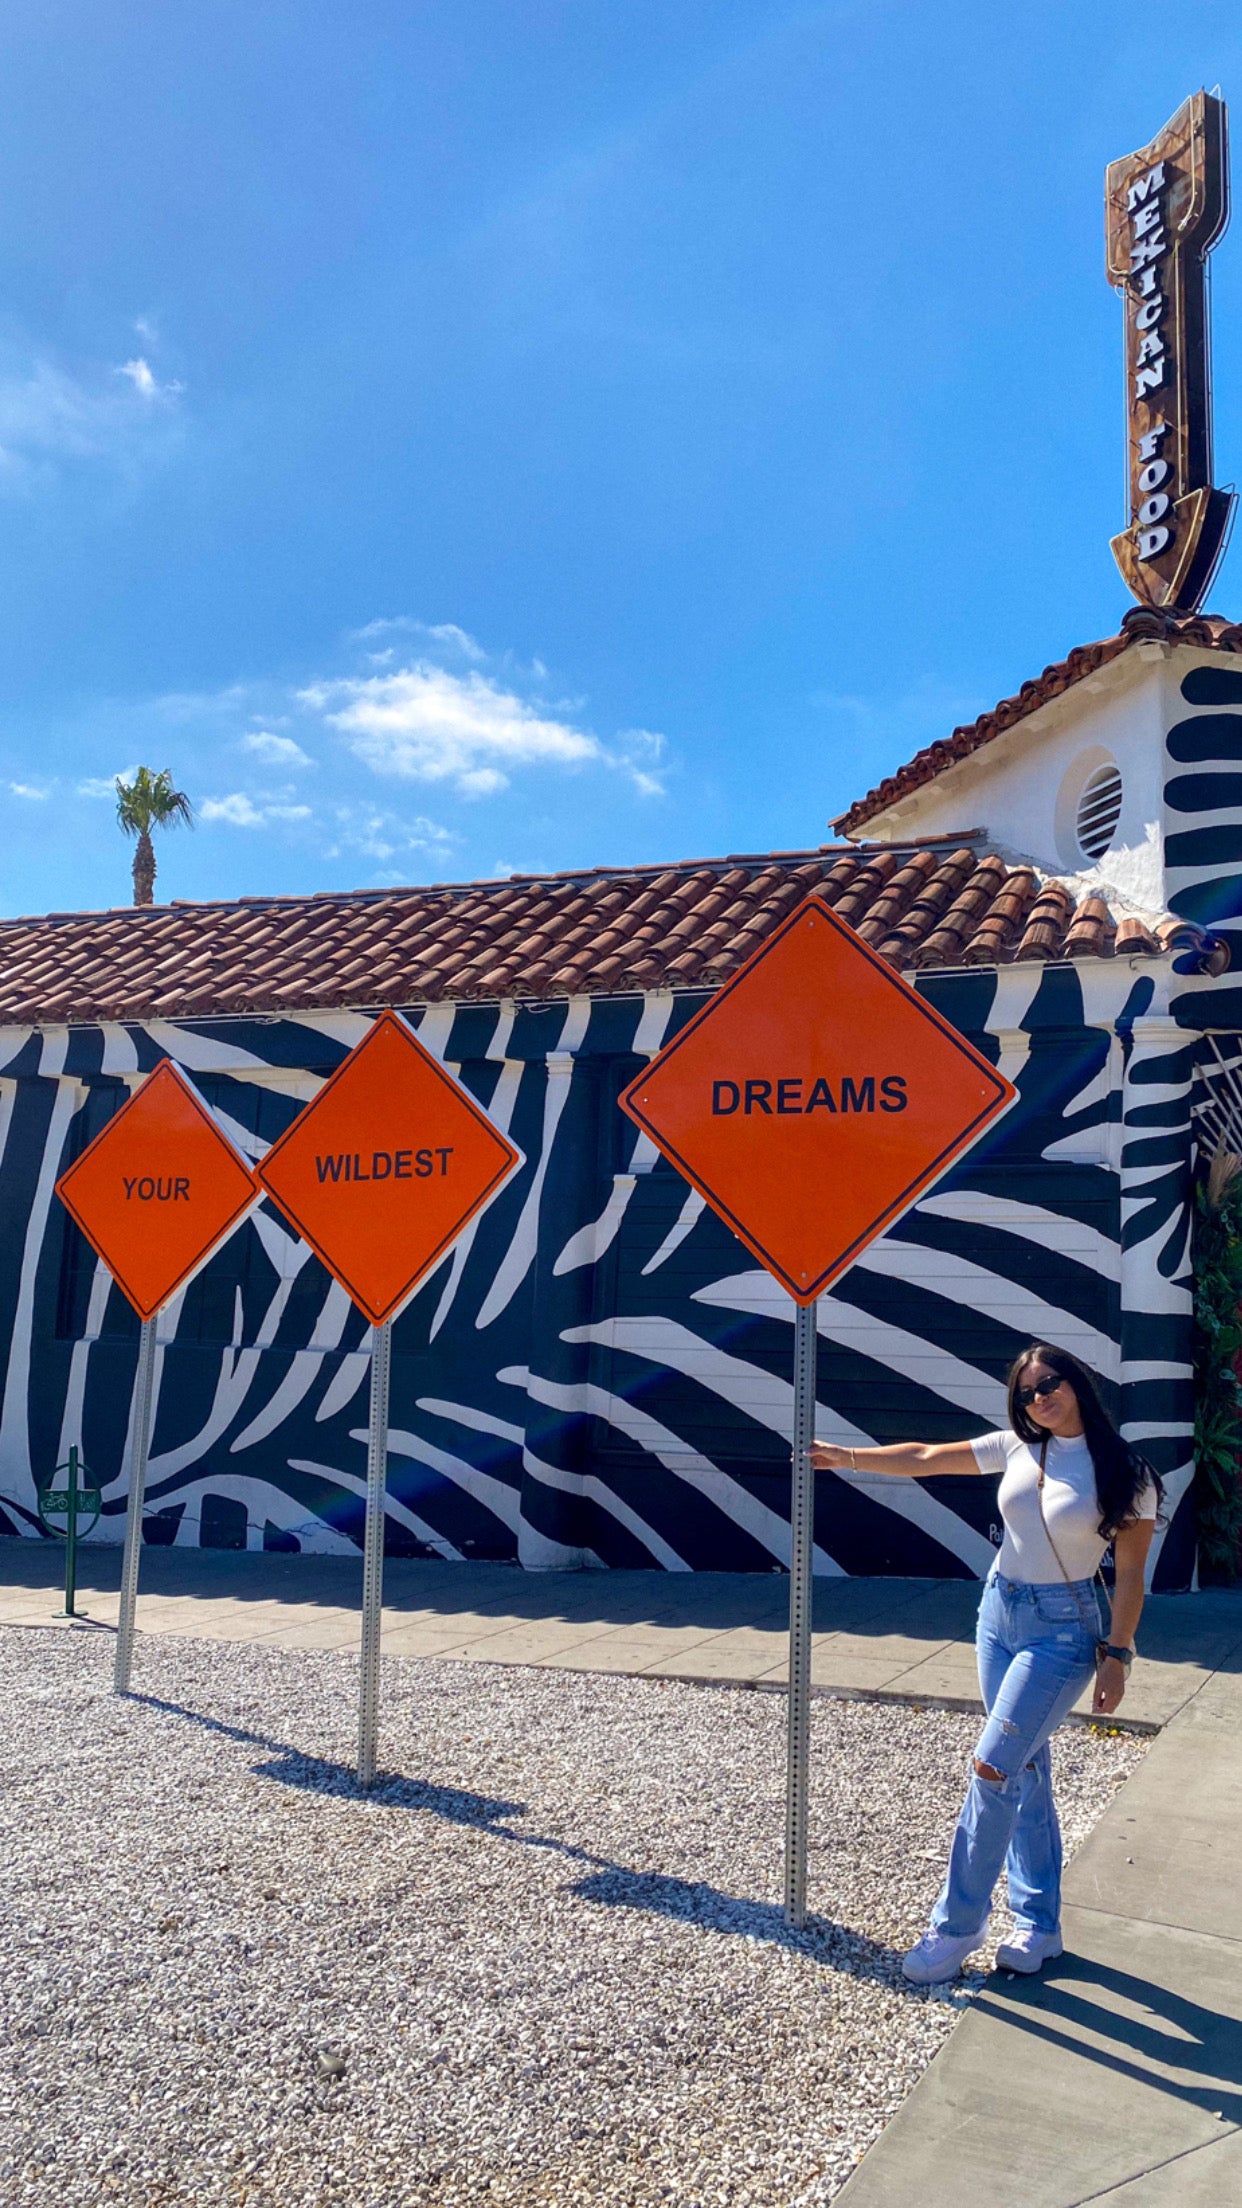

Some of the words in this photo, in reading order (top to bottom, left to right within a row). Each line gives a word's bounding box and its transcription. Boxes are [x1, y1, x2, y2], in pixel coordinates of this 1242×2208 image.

[1127, 160, 1167, 399] MEXICAN
[1138, 423, 1169, 561] FOOD
[712, 1076, 908, 1115] DREAMS
[316, 1148, 453, 1182] WILDEST
[123, 1178, 190, 1200] YOUR
